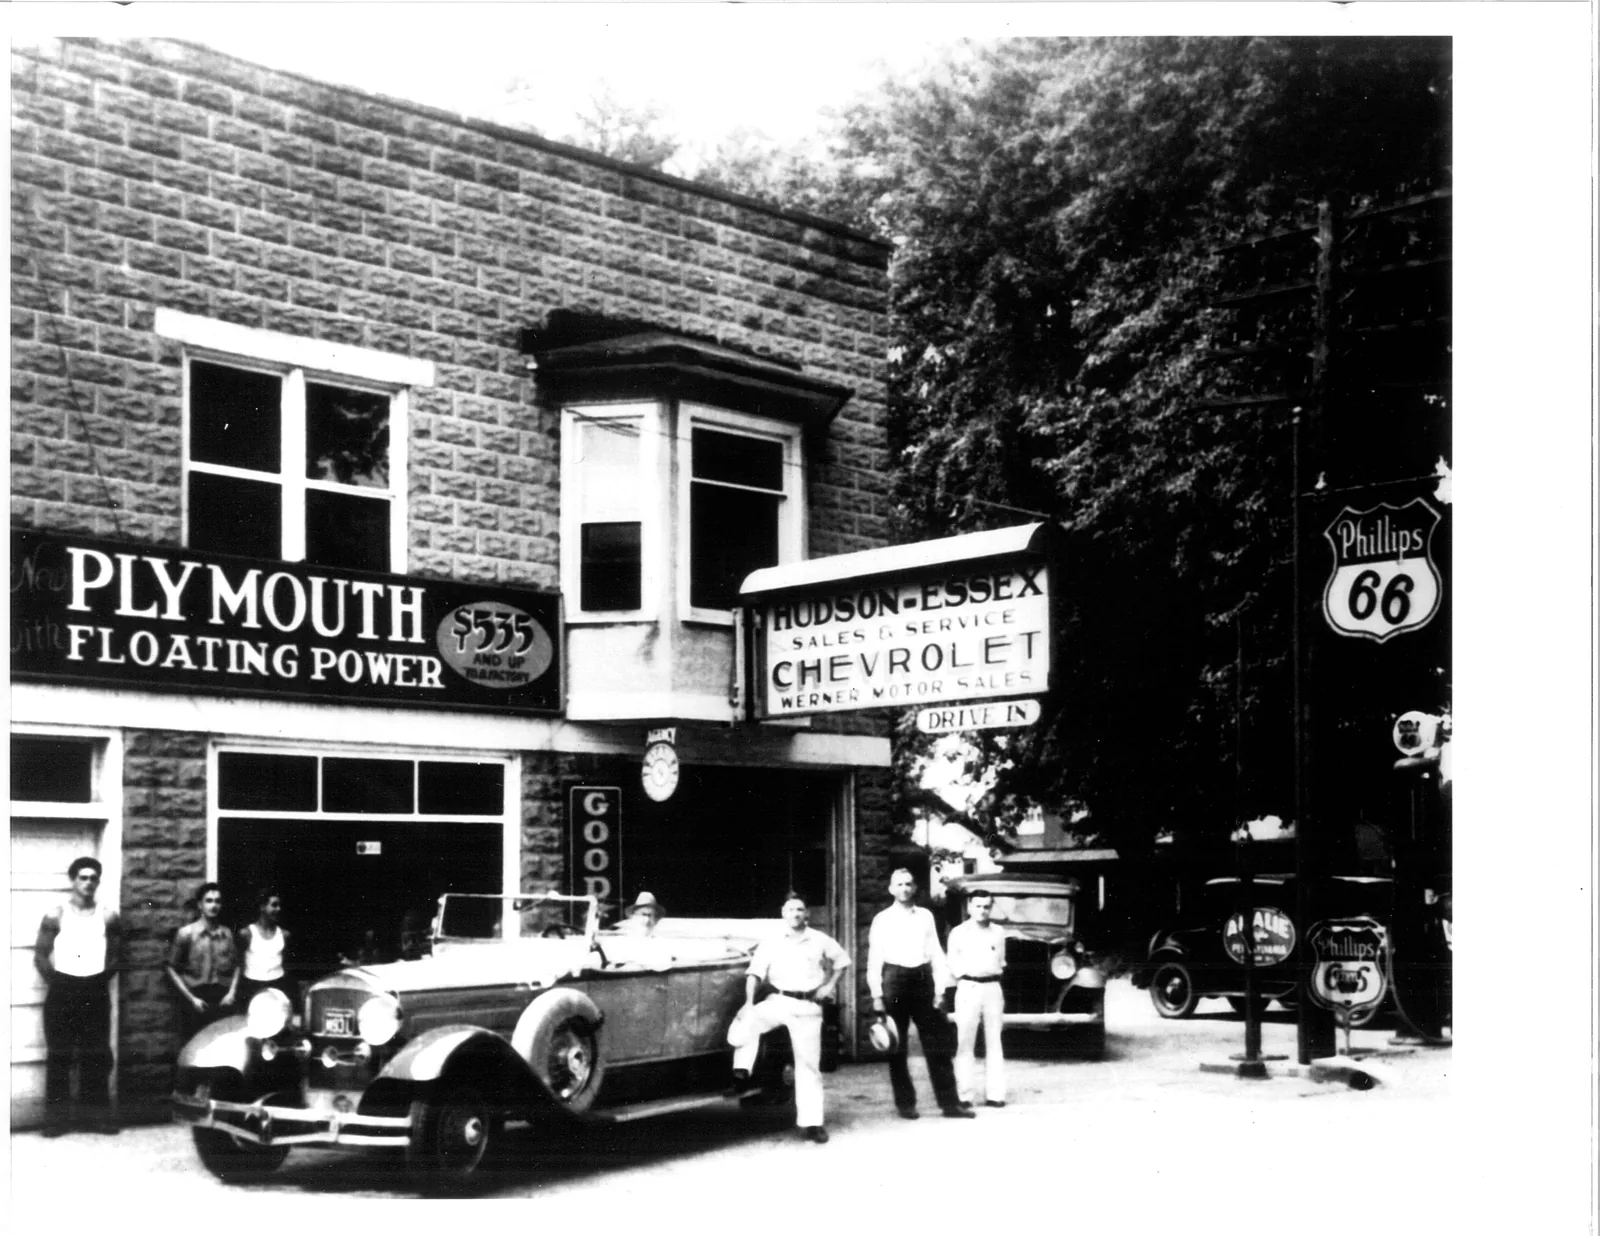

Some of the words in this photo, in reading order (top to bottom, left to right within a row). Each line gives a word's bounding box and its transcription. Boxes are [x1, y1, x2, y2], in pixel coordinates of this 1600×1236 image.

[1337, 514, 1423, 565] Phillips
[66, 547, 426, 643] PLYMOUTH
[773, 566, 1043, 631] HUDSON-ESSEX
[1348, 569, 1415, 626] 66
[67, 623, 299, 679] FLOATING
[311, 647, 445, 689] POWER
[451, 606, 534, 656] $535
[792, 629, 865, 650] SALES
[906, 608, 1017, 635] SERVICE
[472, 653, 502, 667] AND
[508, 655, 526, 669] UP
[772, 631, 1041, 689] CHEVROLET
[781, 689, 860, 709] WERNER
[872, 680, 944, 700] MOTOR
[957, 672, 1032, 690] SALES
[929, 705, 994, 730] DRIVE
[1007, 702, 1029, 722] IN
[583, 792, 615, 915] GOOD
